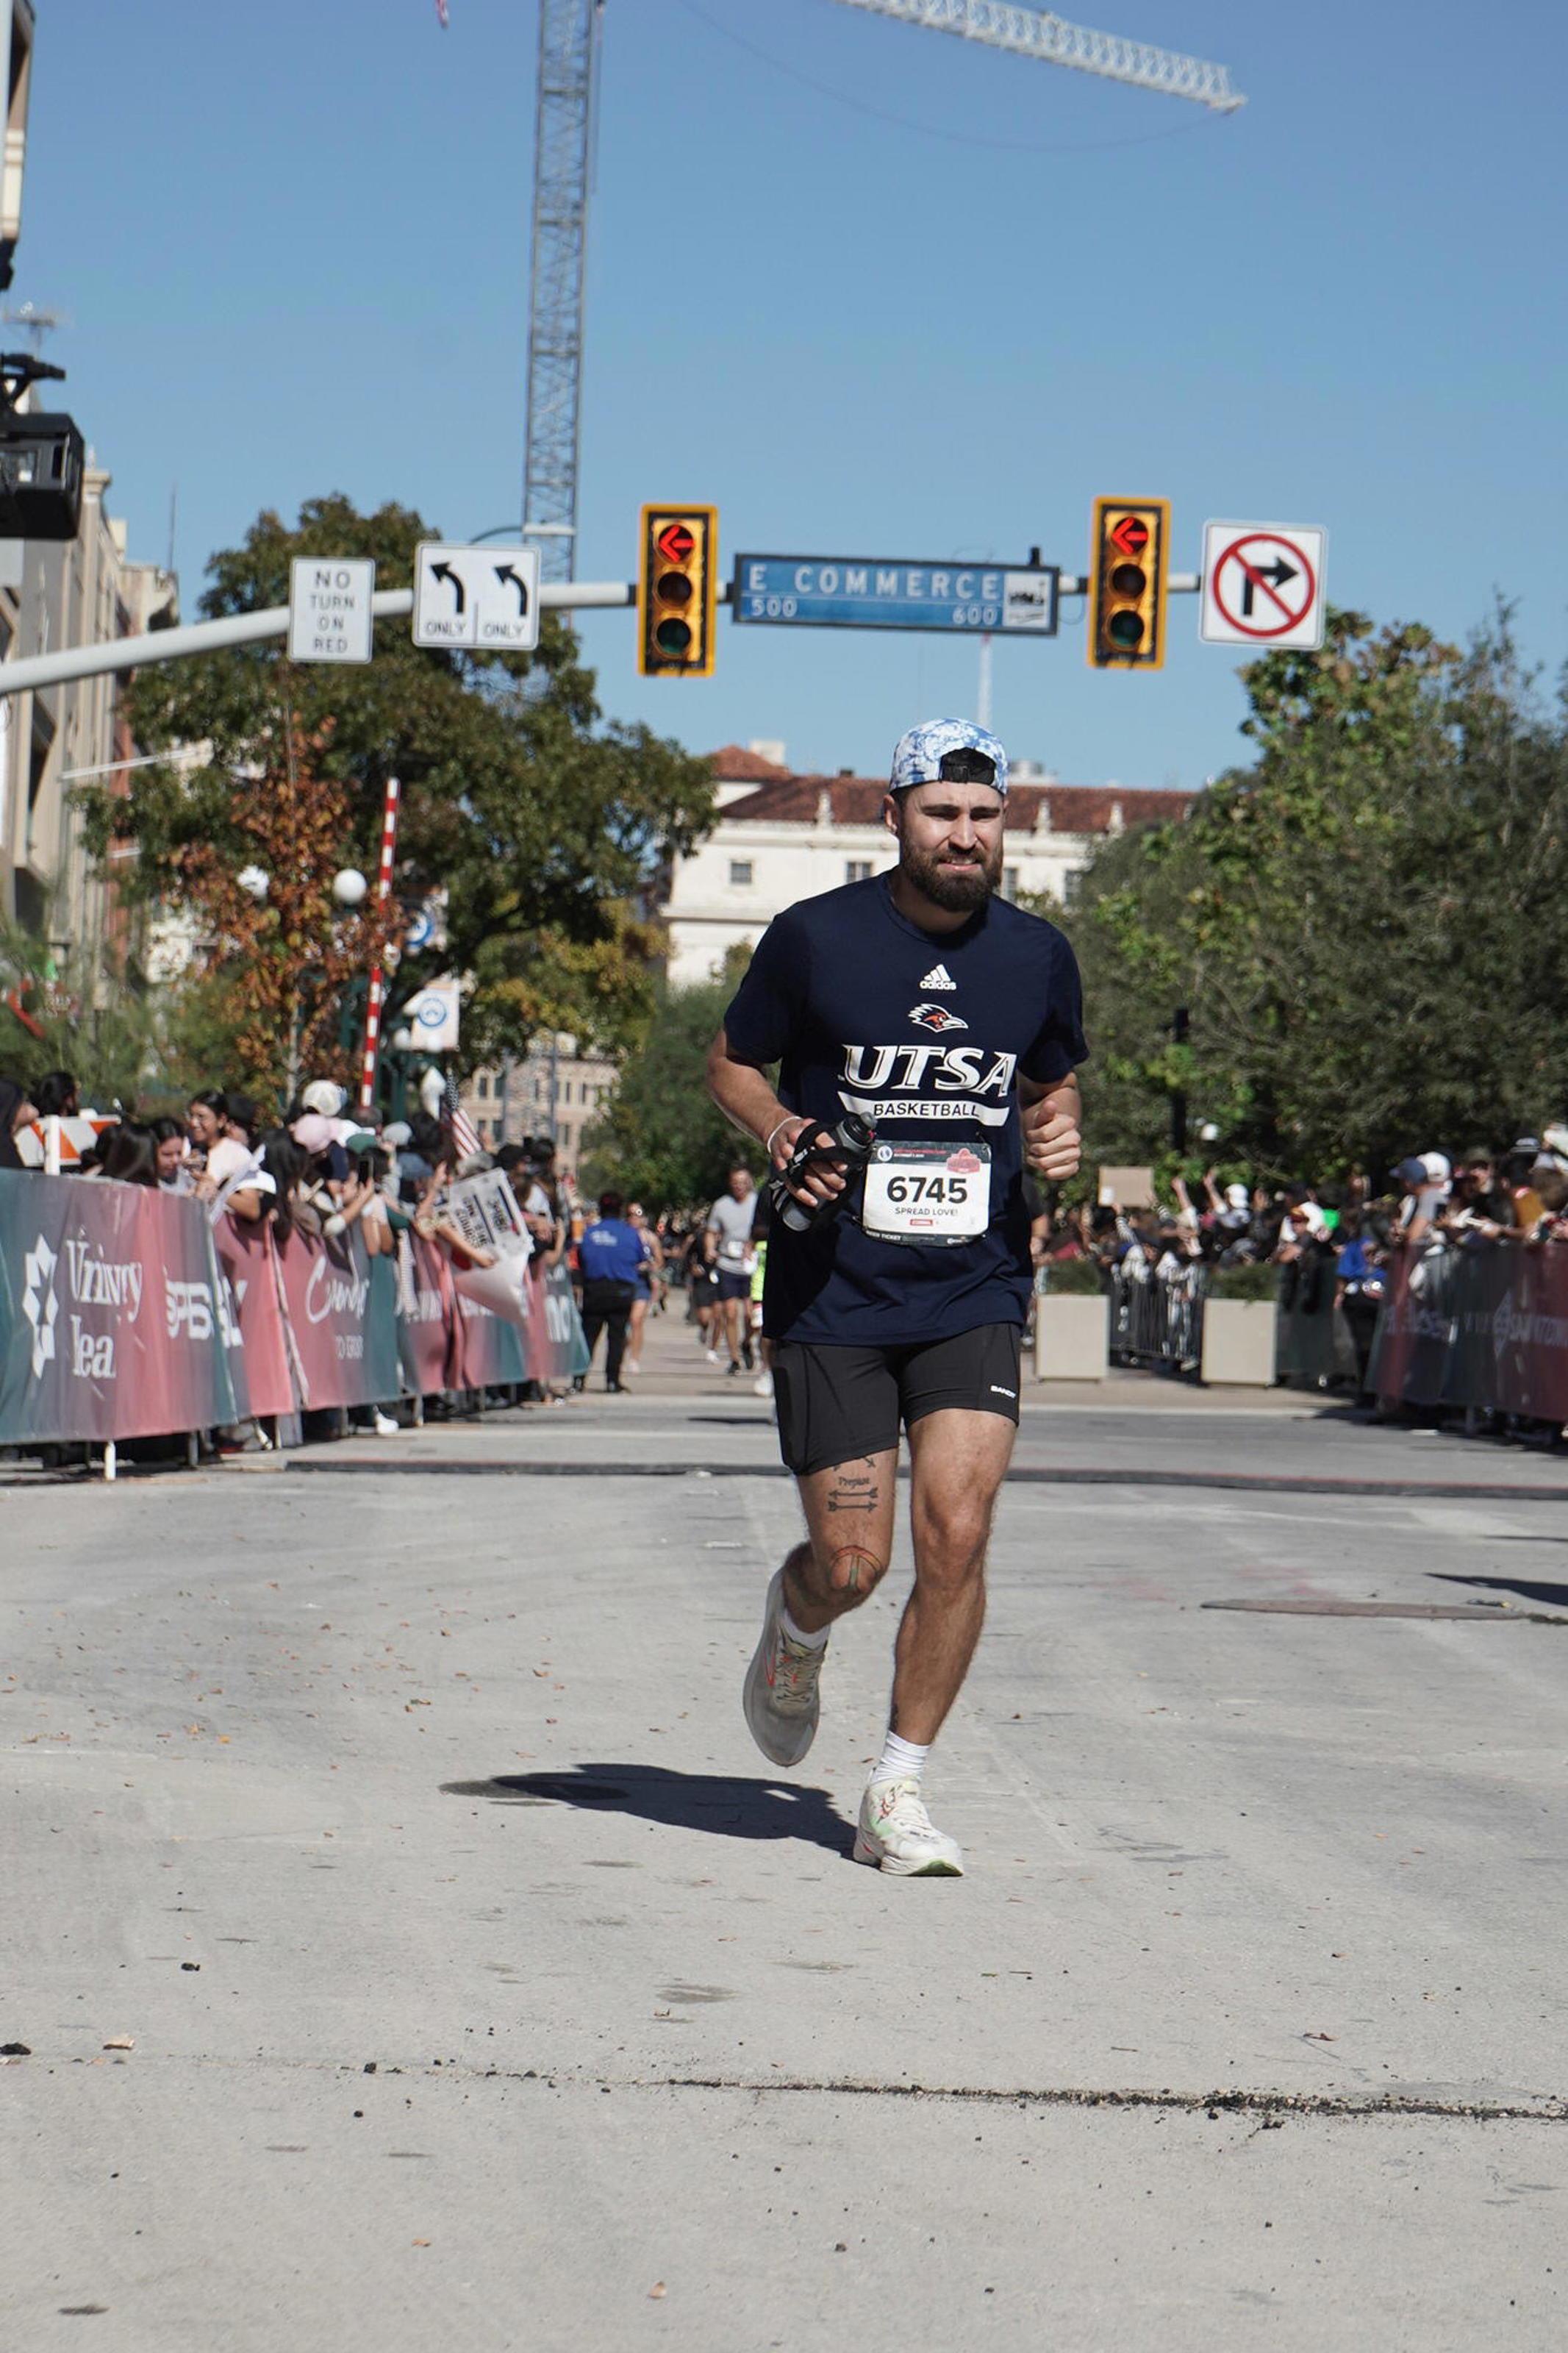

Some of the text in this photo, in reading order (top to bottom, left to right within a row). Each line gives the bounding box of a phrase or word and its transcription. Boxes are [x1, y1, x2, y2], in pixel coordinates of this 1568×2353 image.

[314, 571, 351, 590] NO
[749, 565, 767, 590] E
[794, 567, 1000, 600] COMMERCE
[309, 595, 355, 609] TURN
[751, 596, 798, 618] 500
[953, 605, 999, 626] 600
[318, 617, 345, 632] ON
[425, 621, 467, 638] ONLY
[482, 623, 526, 639] ONLY
[312, 638, 348, 654] RED
[920, 980, 956, 990] adidas
[842, 1044, 1017, 1098] UTSA
[873, 1102, 980, 1118] BASKETBALL
[887, 1176, 967, 1204] 6745
[895, 1207, 931, 1215] SPREAD
